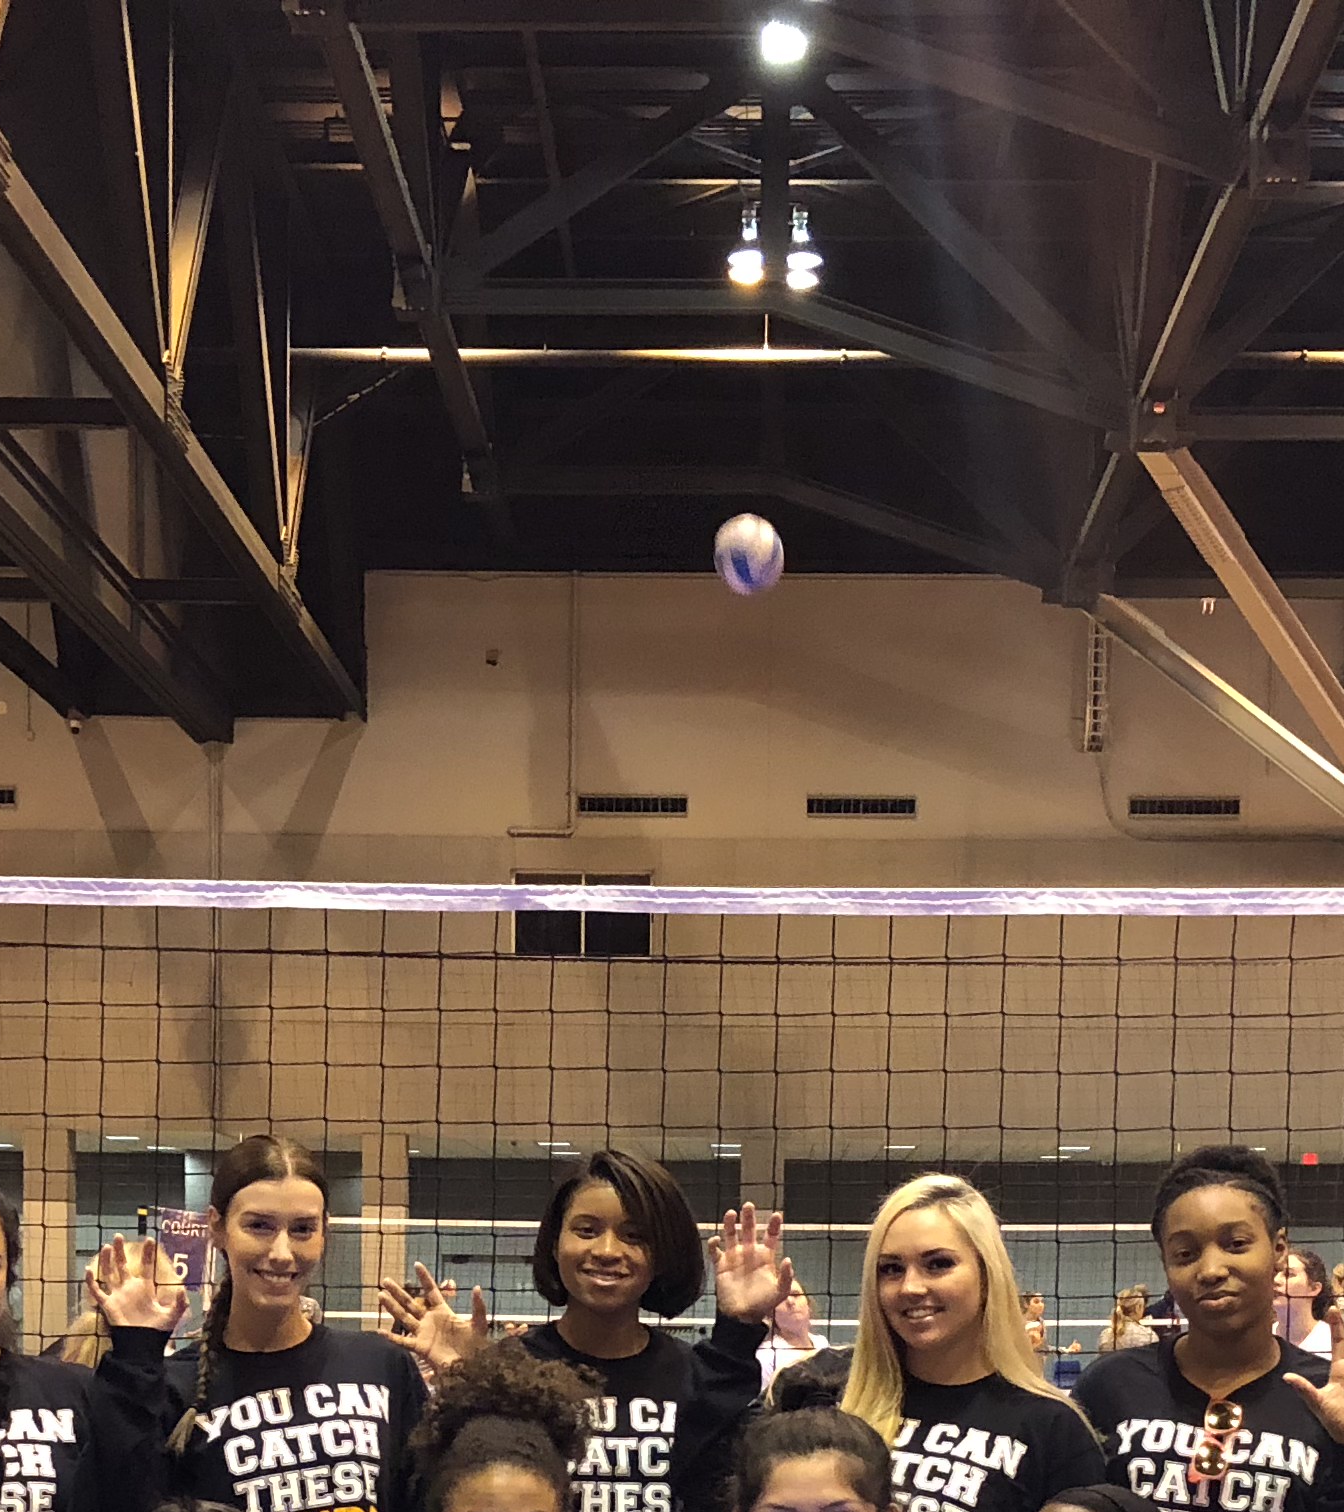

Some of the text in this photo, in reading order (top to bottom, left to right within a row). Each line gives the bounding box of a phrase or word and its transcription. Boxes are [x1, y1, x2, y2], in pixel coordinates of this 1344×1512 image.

[162, 1220, 209, 1238] COURT
[173, 1253, 189, 1281] 5
[194, 1383, 390, 1443] YOU CAN
[223, 1420, 381, 1476] CATCH
[567, 1437, 674, 1477] ATC
[923, 1422, 1028, 1479] CAN
[1116, 1418, 1319, 1485] YOU CAN
[891, 1450, 989, 1507] TCH
